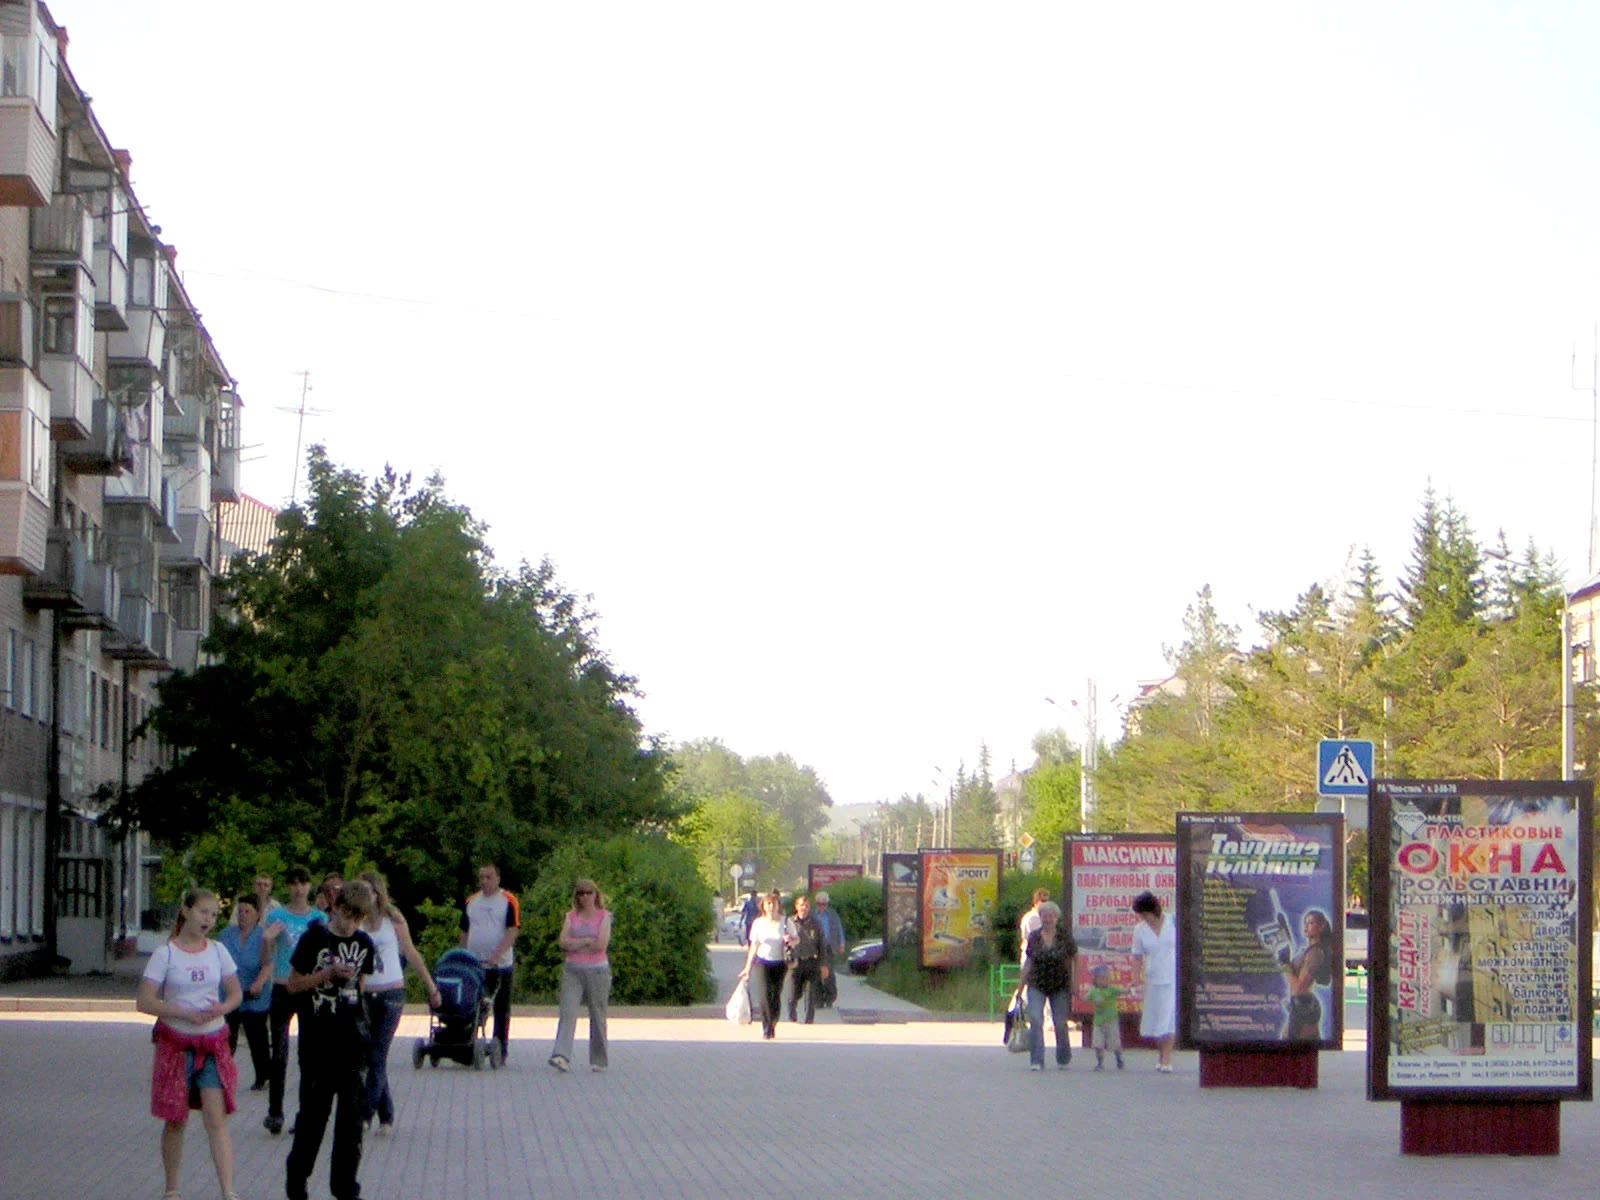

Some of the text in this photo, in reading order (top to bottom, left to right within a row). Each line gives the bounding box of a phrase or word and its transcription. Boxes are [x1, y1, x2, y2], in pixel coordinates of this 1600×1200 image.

[1426, 825, 1563, 840] ПЛАСТИКОВЫЕ
[1398, 842, 1567, 874] ОКНА
[1401, 878, 1569, 892] РОЛЬСТАВНИ
[1400, 894, 1570, 905] НАТЯЖНЫЕ ПОТОЛКИ
[1534, 926, 1569, 937] двери
[1512, 942, 1569, 951] стальные
[1398, 911, 1418, 1009] КРЕДИТ!
[1500, 974, 1569, 983] остекление
[1513, 985, 1569, 998] балконов
